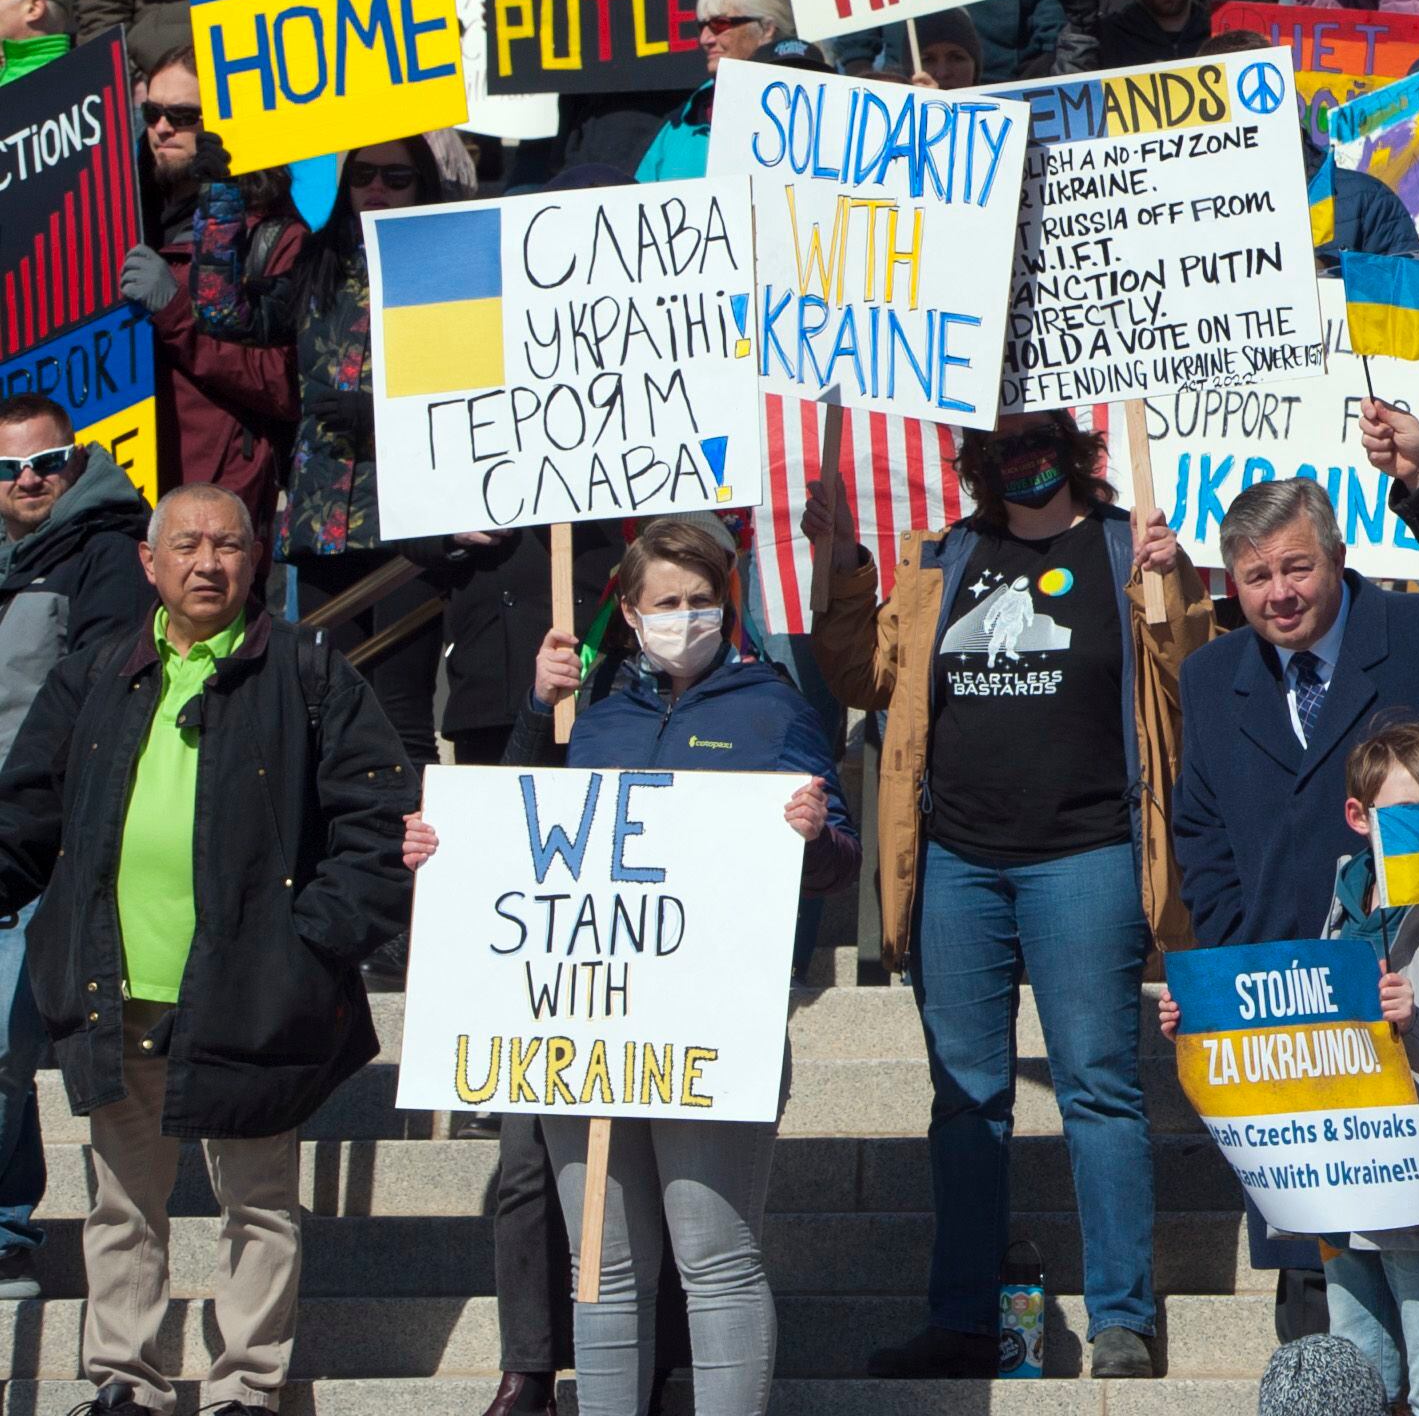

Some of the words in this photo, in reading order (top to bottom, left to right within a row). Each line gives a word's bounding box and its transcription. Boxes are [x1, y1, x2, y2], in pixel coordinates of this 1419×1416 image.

[1021, 62, 1228, 145] EMANDS
[751, 80, 1013, 209] SOLIDARITY
[1080, 150, 1097, 171] A
[1189, 125, 1260, 155] ZONE
[1040, 168, 1158, 207] UKRAINE.
[1041, 206, 1130, 247] RUSSIA
[1136, 198, 1185, 226] OFF
[1191, 189, 1277, 223] FROM
[522, 195, 739, 290] СЛАВА
[783, 183, 927, 311] WITH
[1010, 257, 1168, 310] ANCTION
[1179, 240, 1284, 289] PUTIN
[523, 289, 753, 380] УКРАЇНІ!
[1010, 290, 1169, 340] DIRECTLY.
[1089, 329, 1112, 362] A
[1117, 321, 1192, 357] VOTE
[1198, 313, 1232, 344] ON
[1235, 305, 1297, 340] THE
[758, 283, 985, 415] KRAINE
[1000, 359, 1149, 408] DEFENDING
[1151, 350, 1238, 386] UKRAINE
[426, 368, 700, 471] ГЕРОЯМ
[1143, 387, 1303, 441] SUPPORT
[481, 434, 734, 526] СЛАВА!
[947, 669, 1063, 684] HEARTLESS
[954, 682, 1057, 696] BASTARDS
[518, 771, 675, 885] WE
[490, 890, 686, 958] STAND
[525, 959, 631, 1021] WITH
[1234, 959, 1339, 1021] STOJÍME
[454, 1033, 719, 1108] UKRAINE
[1202, 1037, 1240, 1085] ZA
[1242, 1027, 1382, 1084] UKRAJINOU!
[1244, 1119, 1318, 1148] Czechs
[1323, 1117, 1339, 1142] &
[1342, 1113, 1418, 1141] Slovaks
[1269, 1161, 1320, 1190] With
